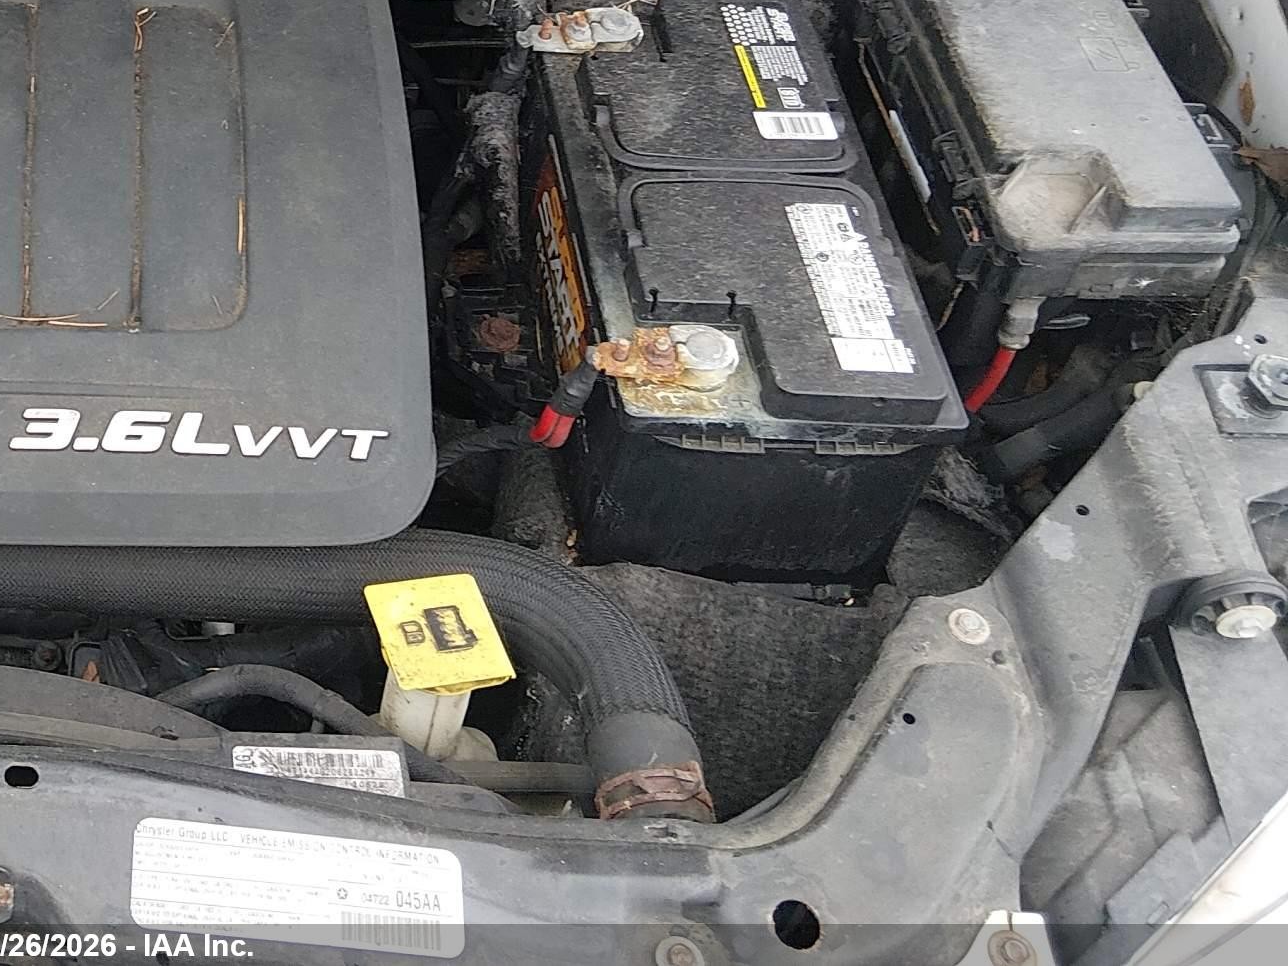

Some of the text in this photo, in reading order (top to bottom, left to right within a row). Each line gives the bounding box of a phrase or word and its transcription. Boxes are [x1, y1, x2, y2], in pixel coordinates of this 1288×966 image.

[136, 822, 175, 838] Chrysler
[178, 826, 208, 841] Group
[210, 828, 229, 842] LLC
[395, 889, 441, 913] 045AA
